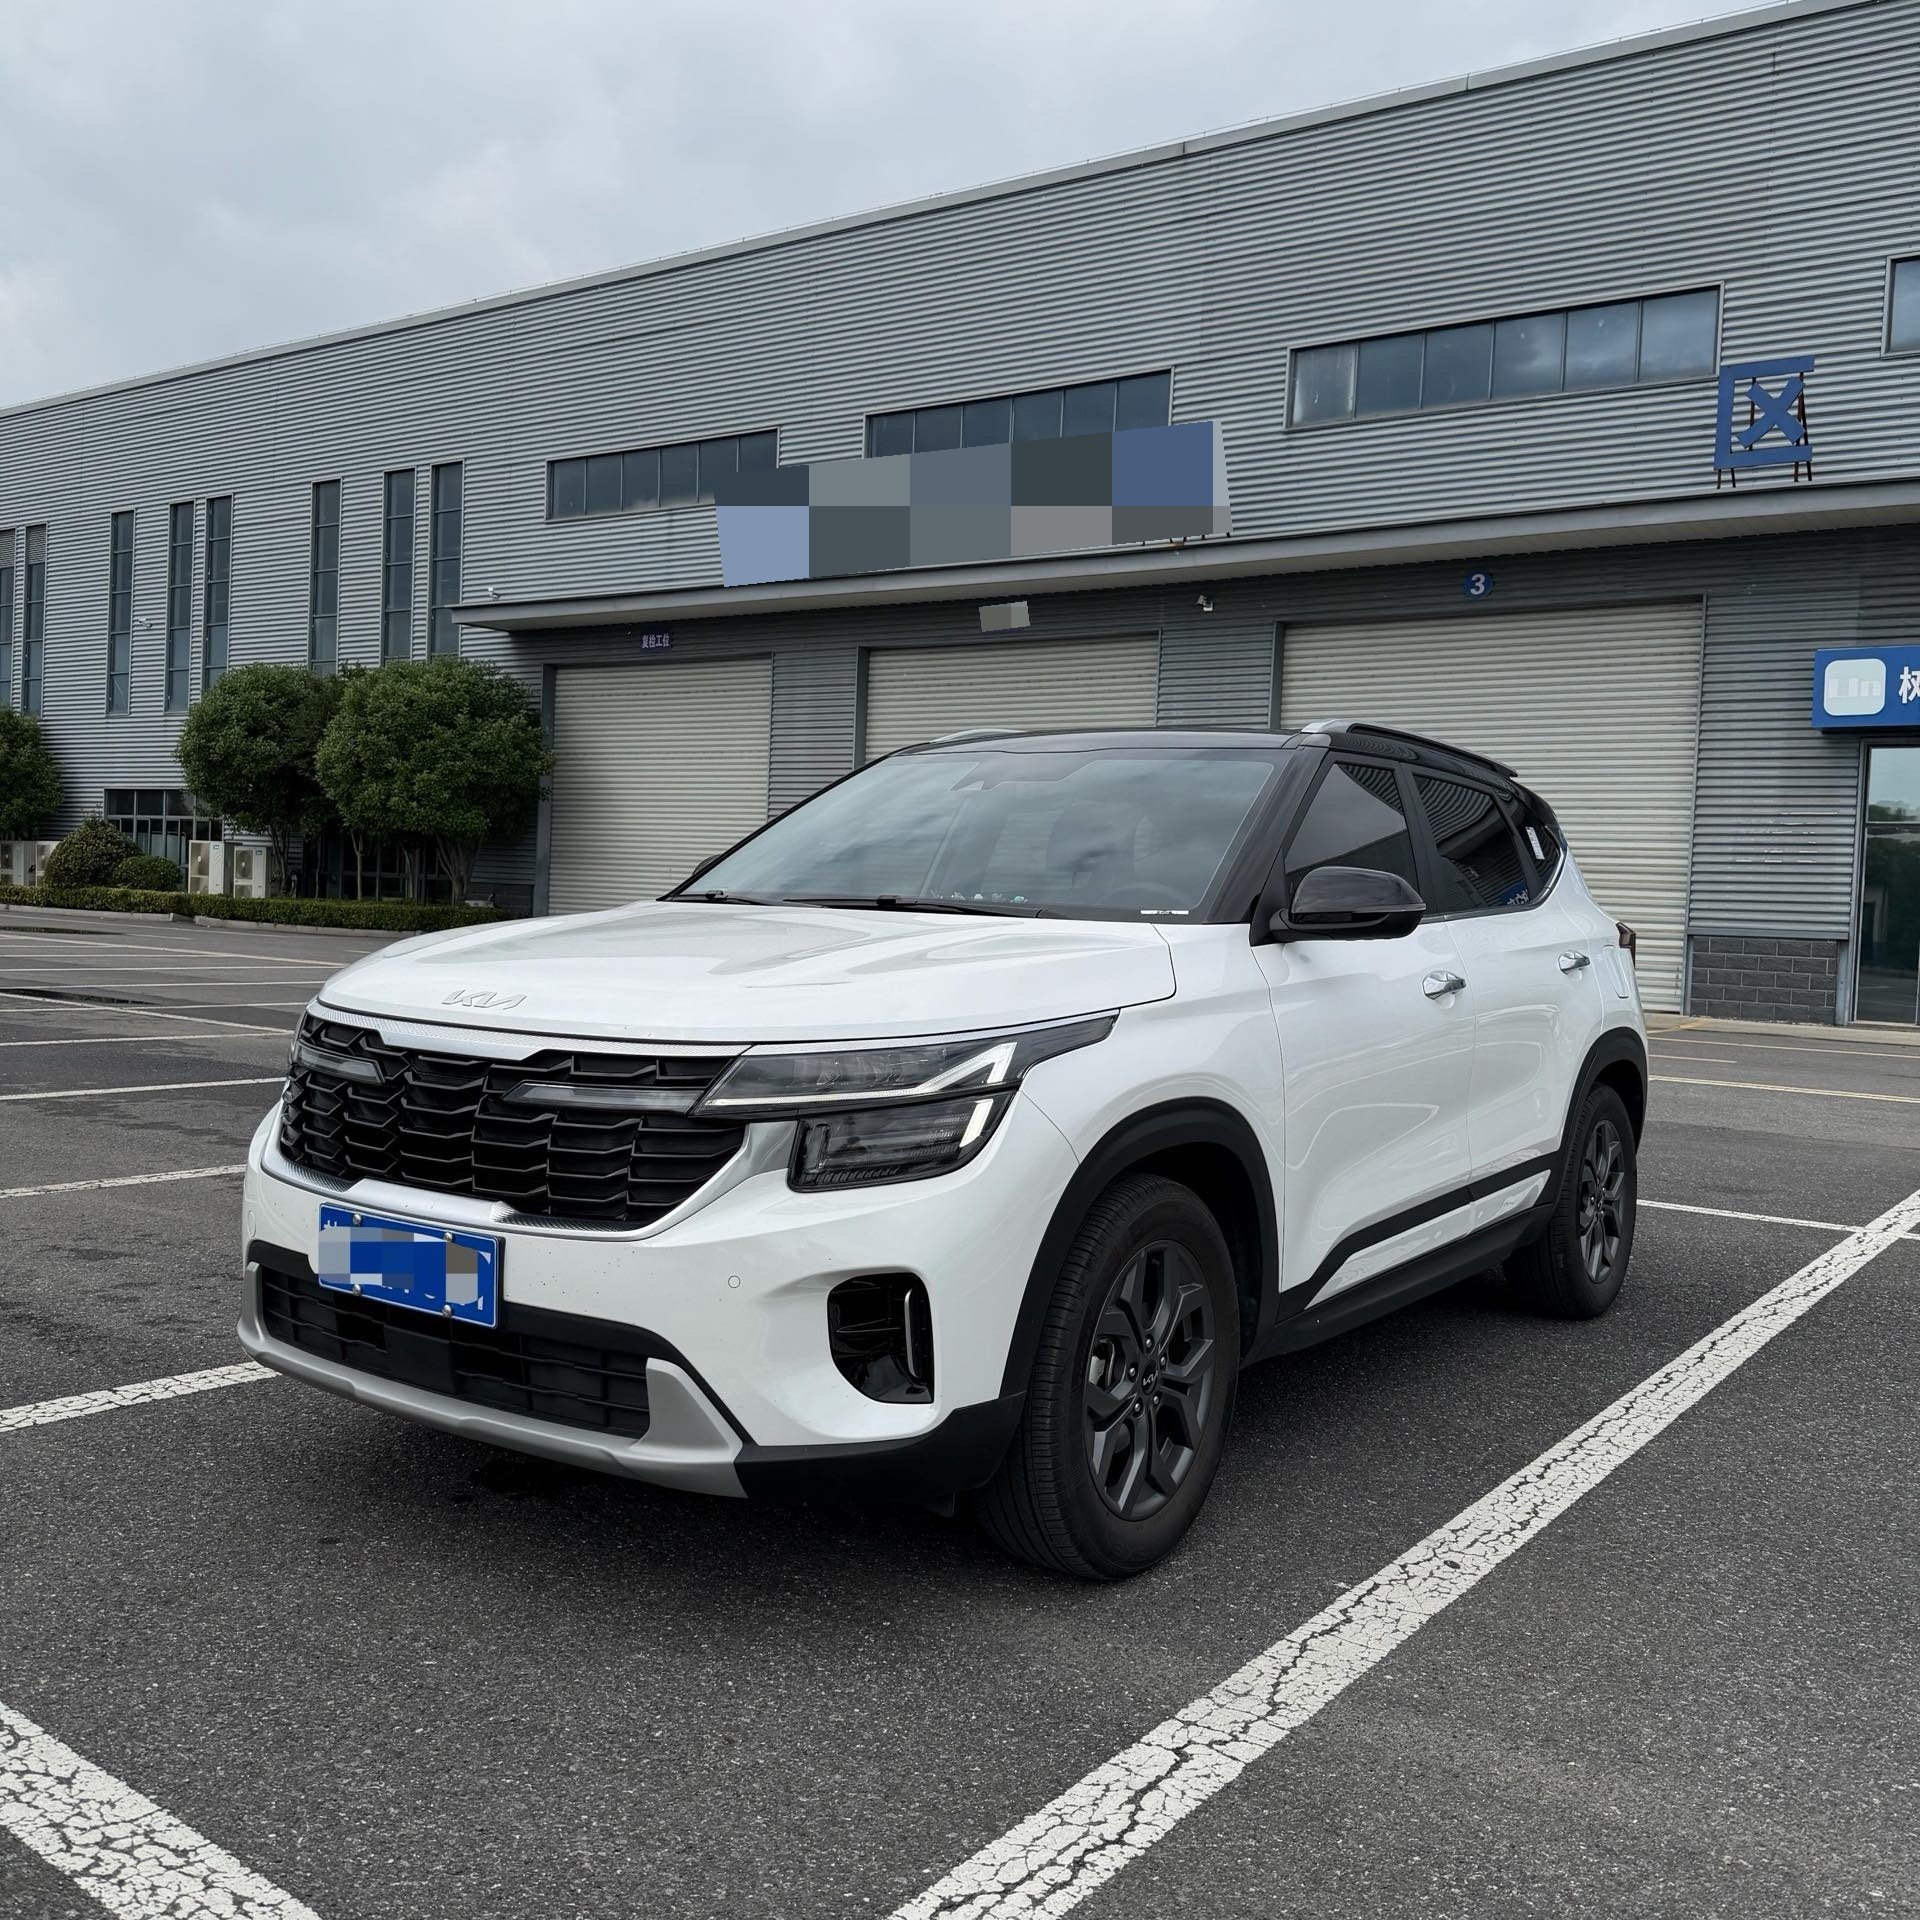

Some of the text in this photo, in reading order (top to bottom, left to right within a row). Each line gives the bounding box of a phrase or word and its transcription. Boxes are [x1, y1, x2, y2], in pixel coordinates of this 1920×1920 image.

[1713, 355, 1815, 470] 区
[1470, 573, 1486, 595] 3
[441, 989, 527, 1010] KIA
